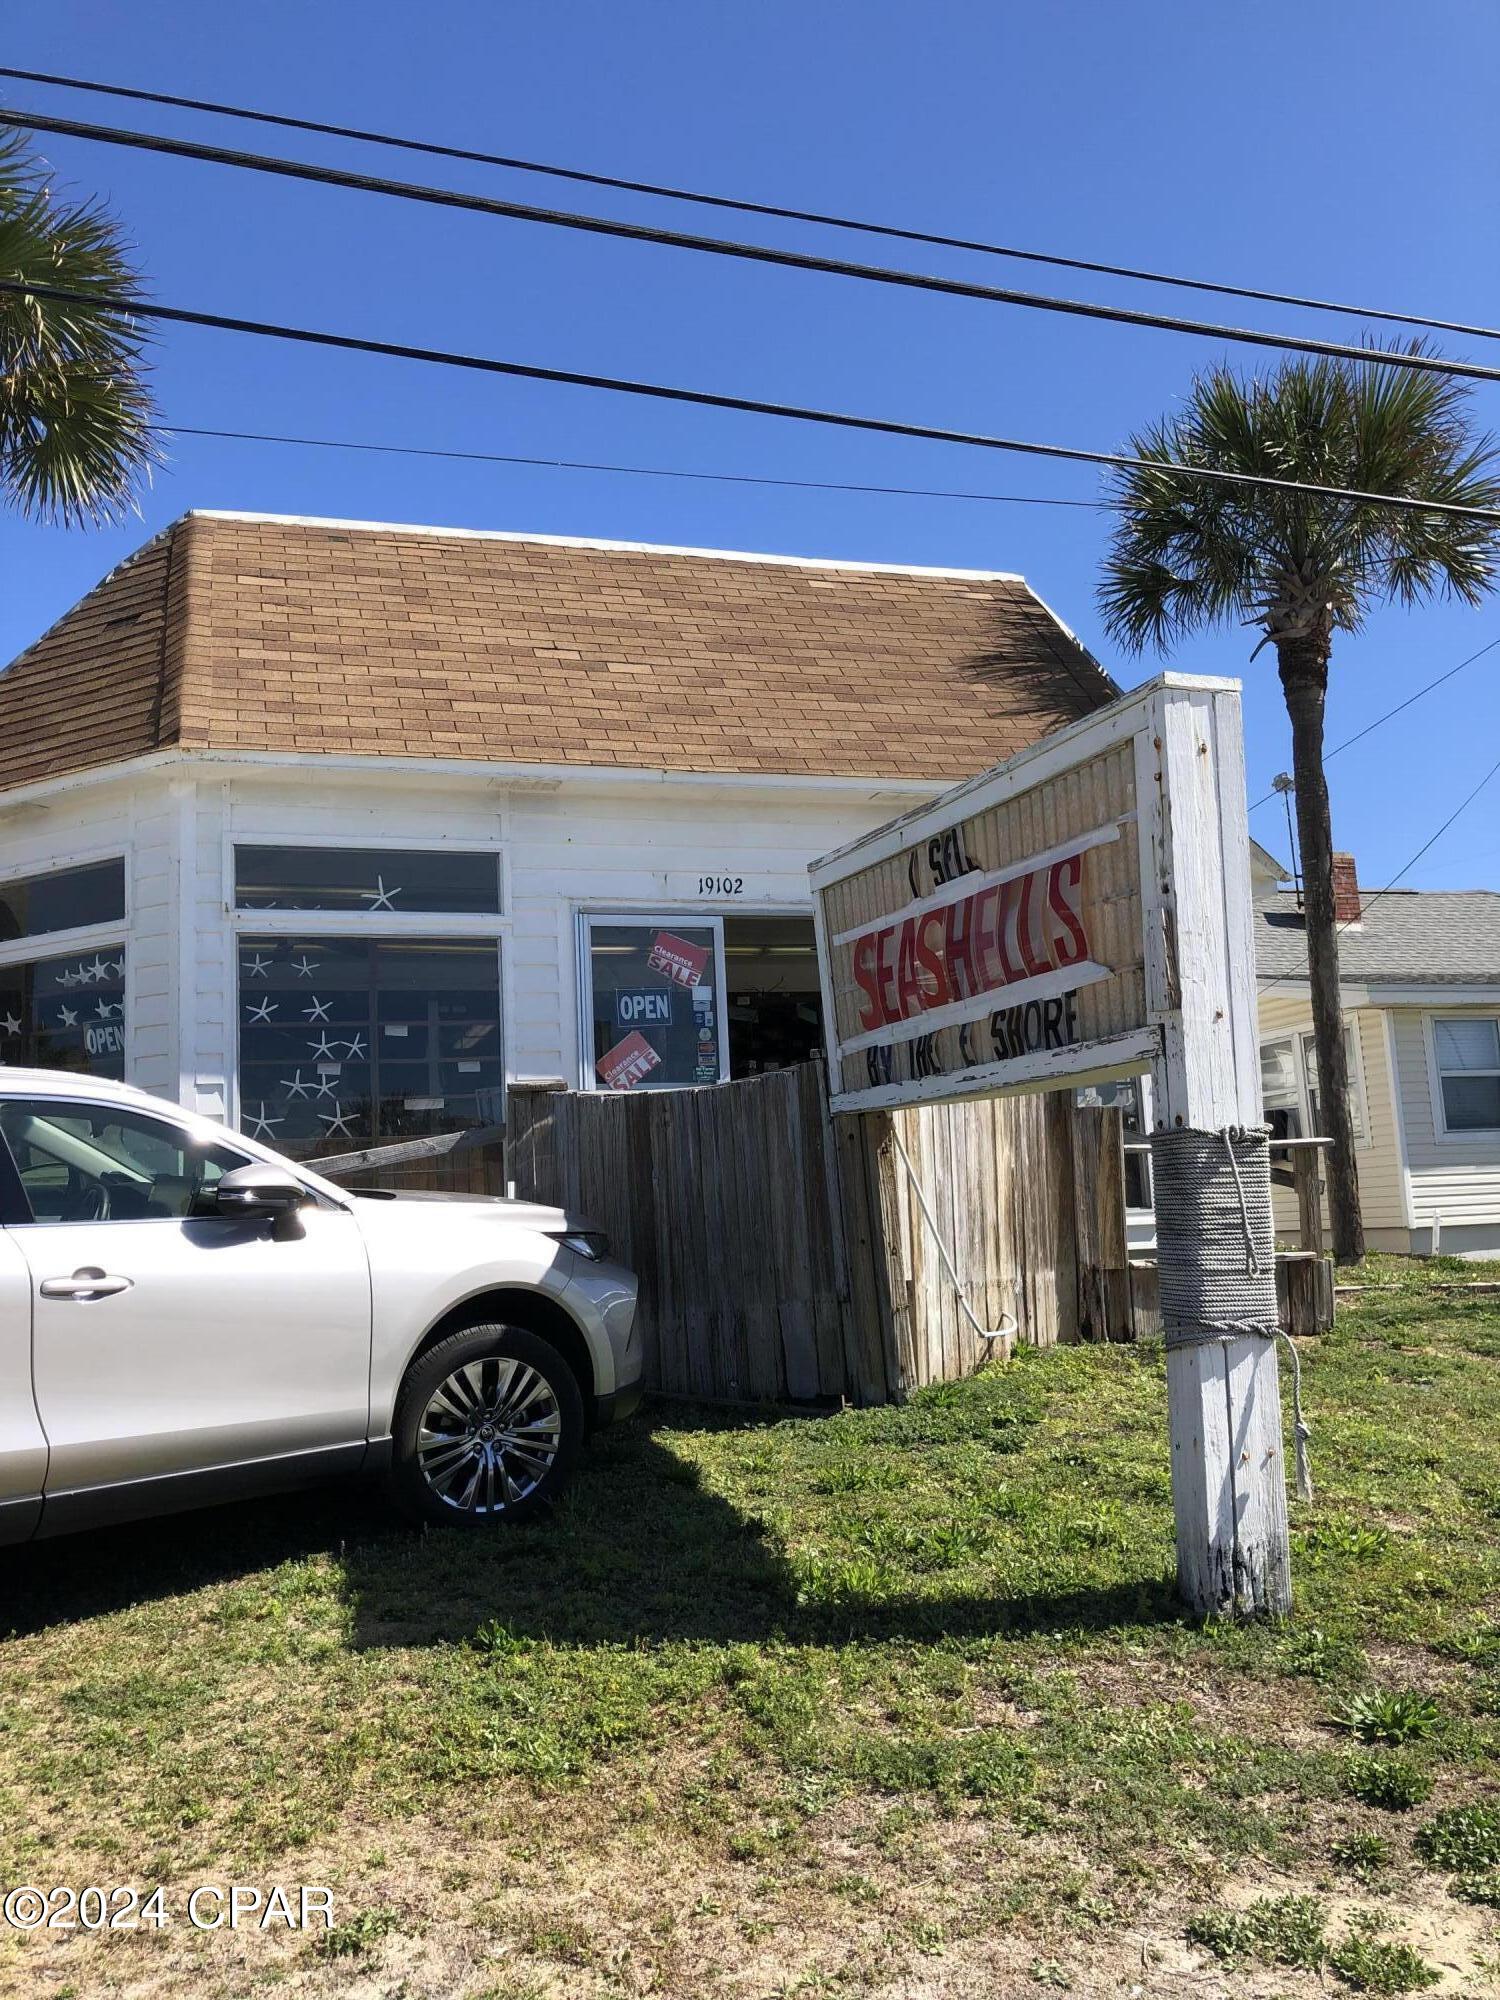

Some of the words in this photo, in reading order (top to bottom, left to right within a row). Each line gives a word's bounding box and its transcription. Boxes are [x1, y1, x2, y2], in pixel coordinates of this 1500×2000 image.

[698, 877, 743, 895] 19102
[654, 945, 694, 969] Clearance
[854, 853, 1089, 1032] SEASHELLS
[649, 955, 702, 986] SALE
[620, 995, 669, 1020] OPEN
[86, 1025, 125, 1054] OPEN
[990, 988, 1078, 1061] SHORE
[613, 1050, 658, 1090] SALE
